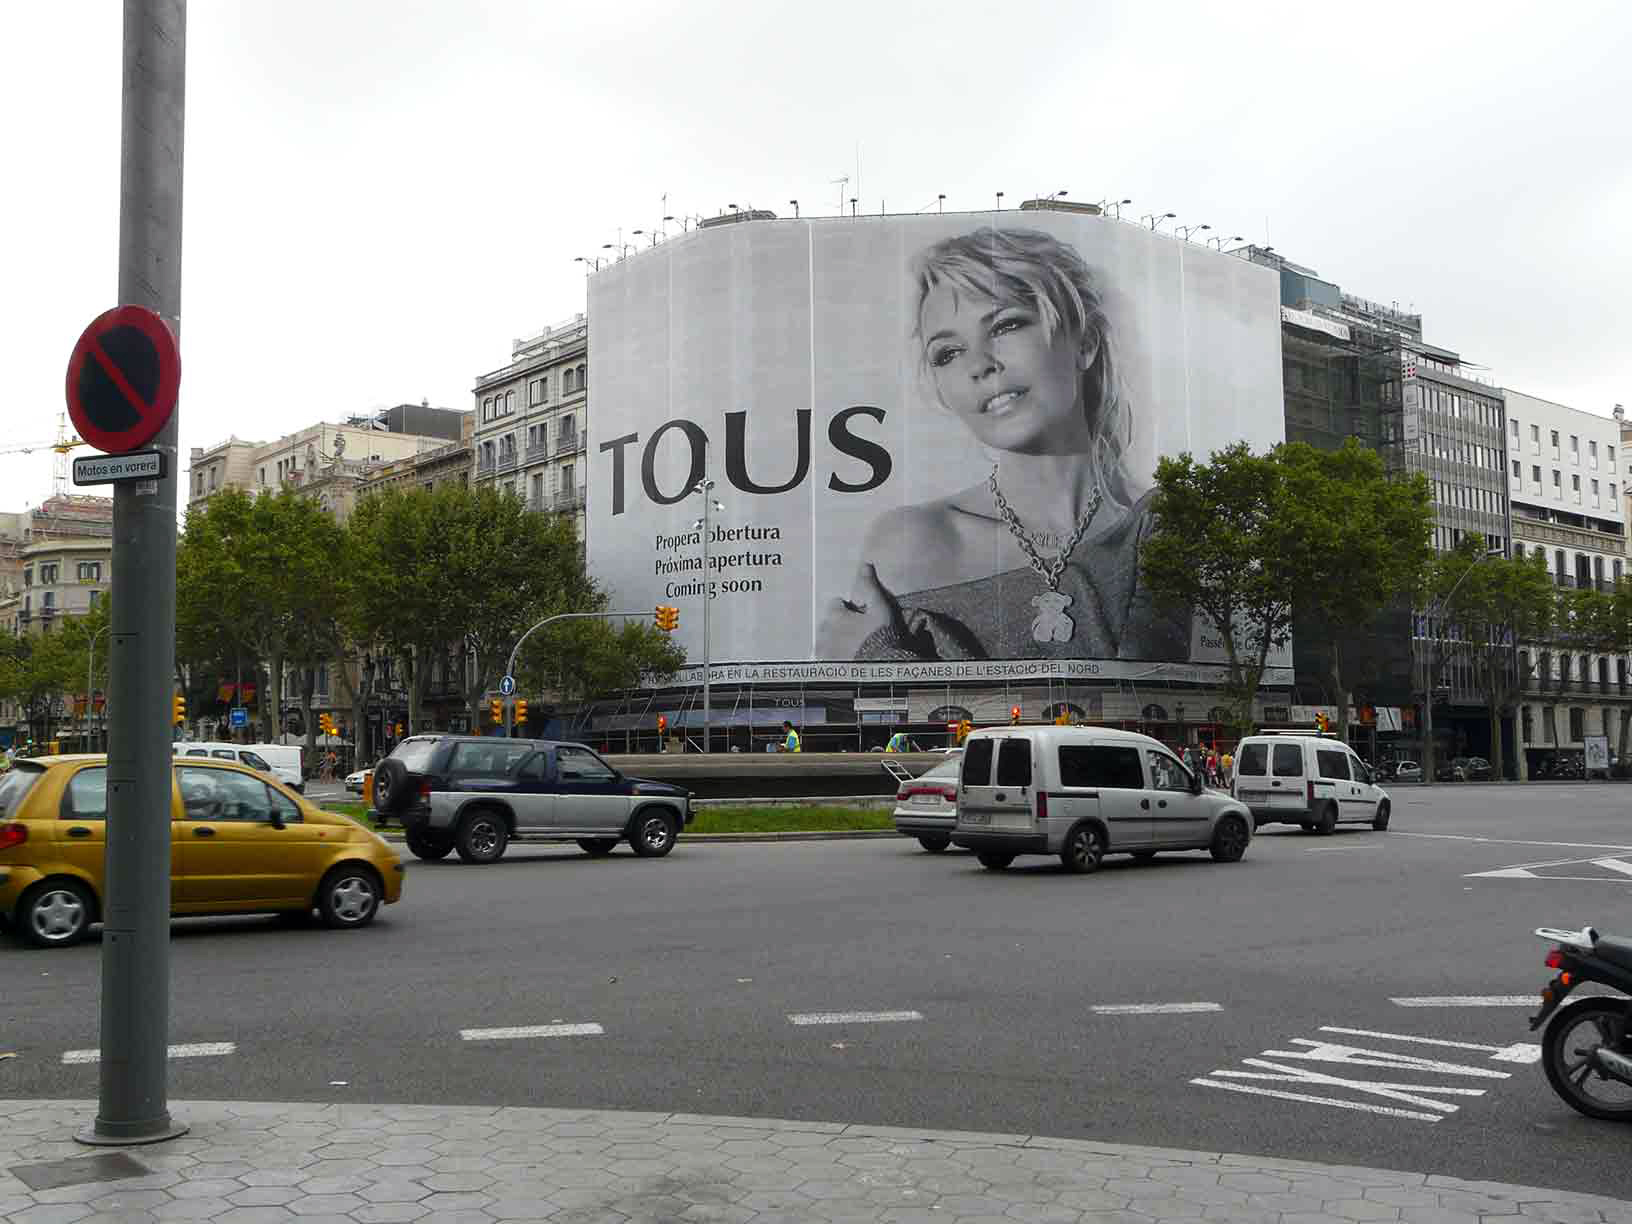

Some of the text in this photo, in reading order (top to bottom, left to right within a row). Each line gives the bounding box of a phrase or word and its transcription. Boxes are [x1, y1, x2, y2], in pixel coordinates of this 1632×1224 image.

[78, 461, 157, 477] Motos en vorera
[599, 405, 893, 516] TOUS
[656, 531, 700, 552] Propera
[655, 551, 782, 575] Próxima apertura
[665, 578, 762, 600] Coming soon
[727, 668, 741, 680] EN
[745, 668, 760, 679] LA
[851, 667, 866, 678] DE
[871, 666, 893, 677] LES
[897, 667, 953, 679] FAÇANES
[956, 667, 976, 678] DE
[1041, 663, 1064, 674] DEL
[1068, 664, 1100, 675] NORD
